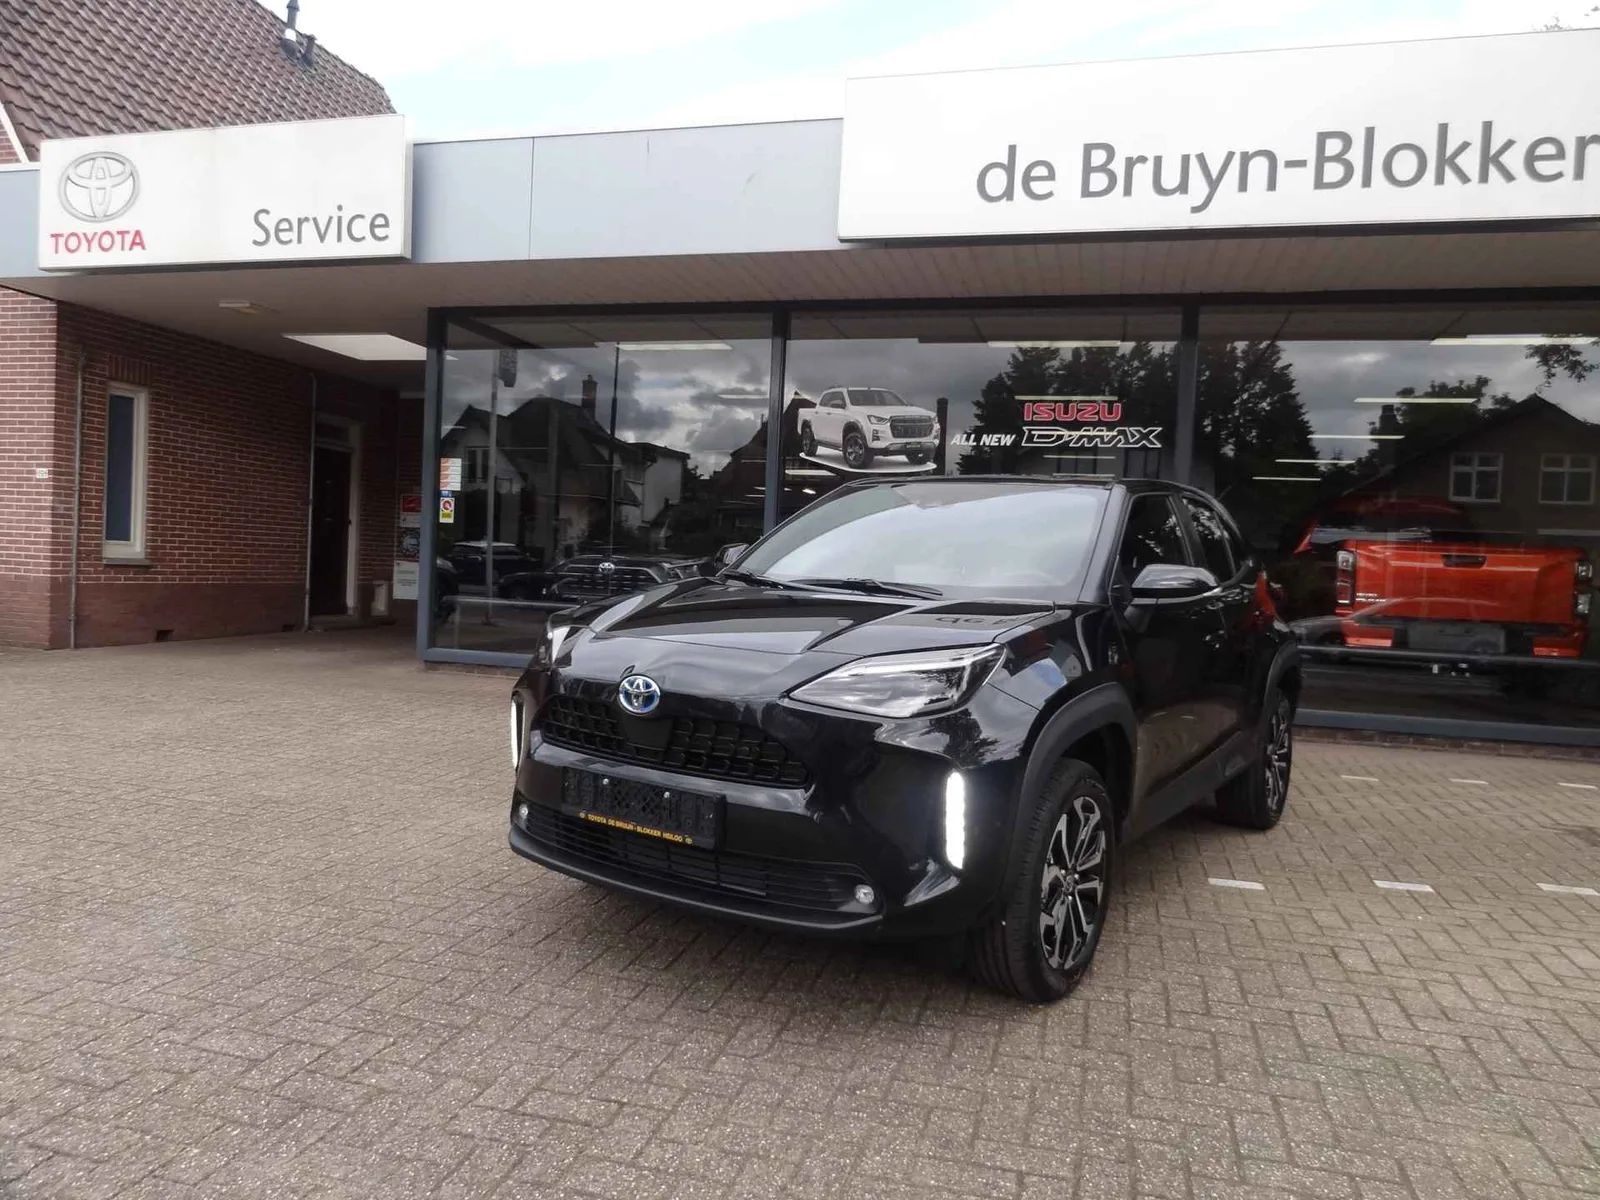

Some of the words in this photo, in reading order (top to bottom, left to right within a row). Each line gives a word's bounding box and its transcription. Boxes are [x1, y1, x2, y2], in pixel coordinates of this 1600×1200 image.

[976, 144, 1056, 203] de
[1080, 120, 1600, 214] Bruyn-Blokker
[252, 204, 390, 247] Service
[51, 230, 146, 254] TOYOTA
[1023, 403, 1121, 421] ISUZU
[951, 434, 977, 446] ALL
[979, 434, 1016, 446] NEW
[588, 813, 607, 824] TOYOTA
